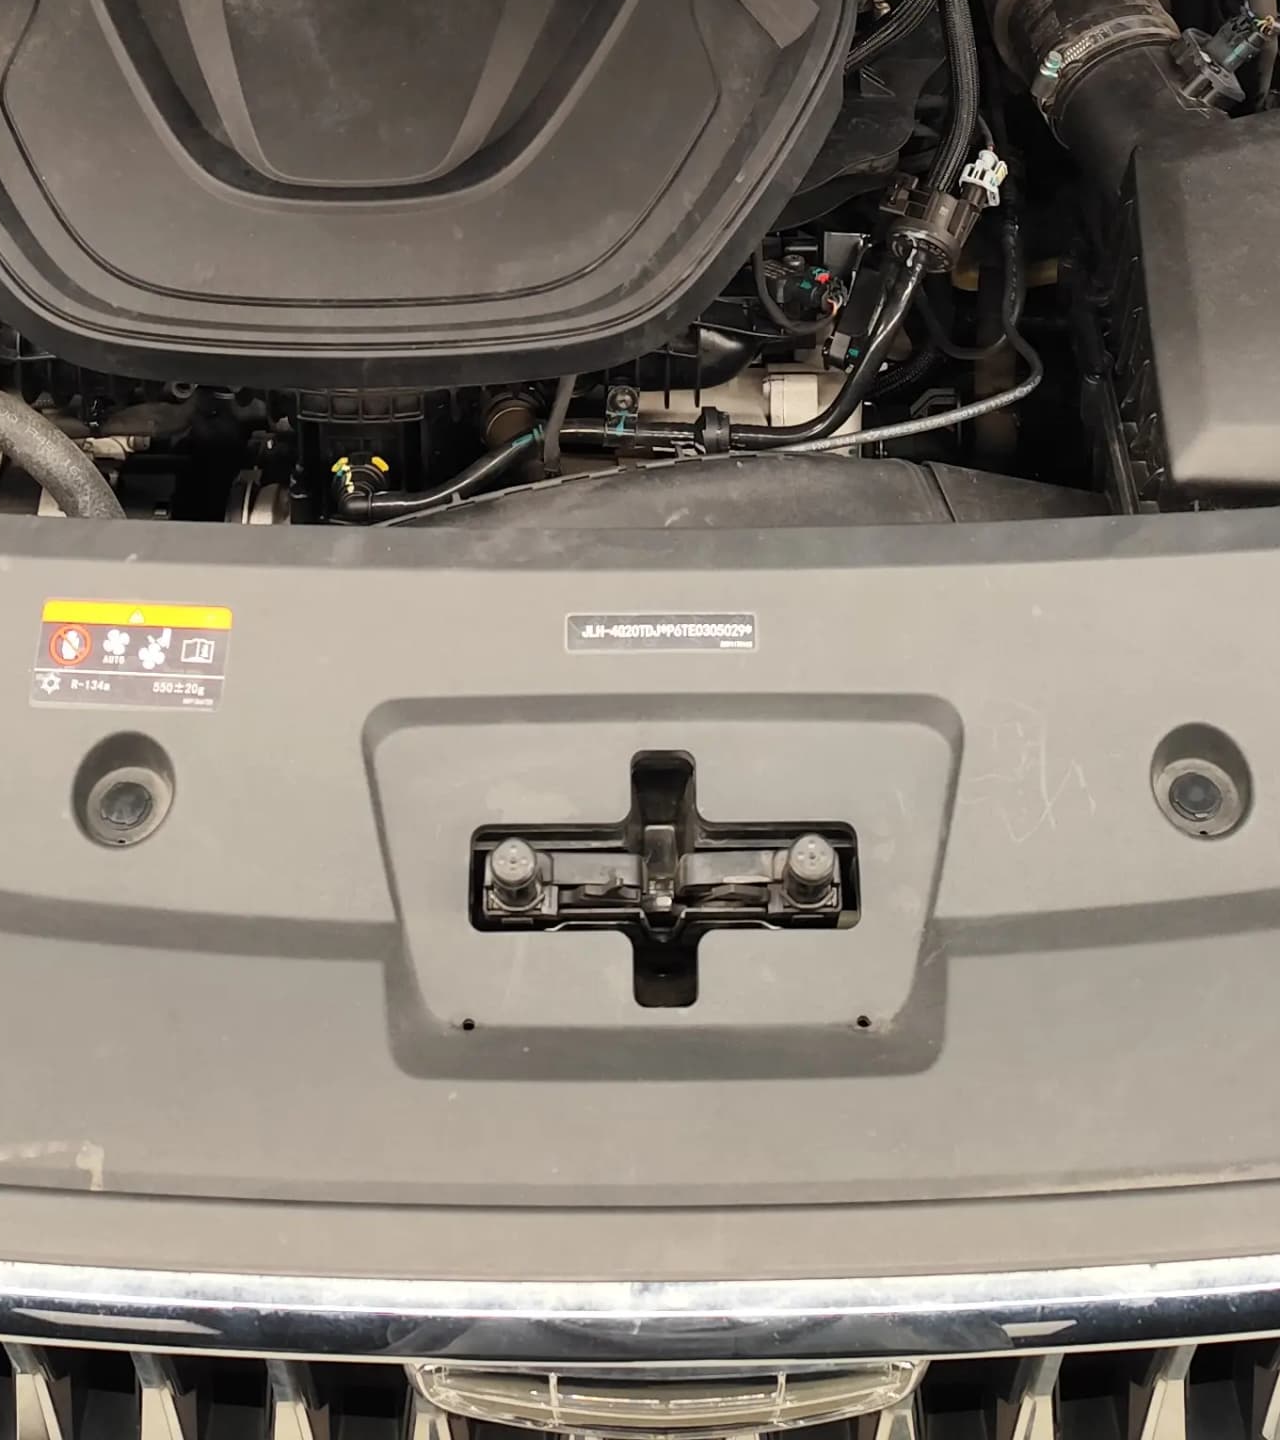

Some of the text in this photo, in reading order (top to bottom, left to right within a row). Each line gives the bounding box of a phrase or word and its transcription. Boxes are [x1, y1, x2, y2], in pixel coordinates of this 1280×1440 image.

[102, 654, 126, 665] AUTO
[70, 679, 206, 697] R-134a 550±20g
